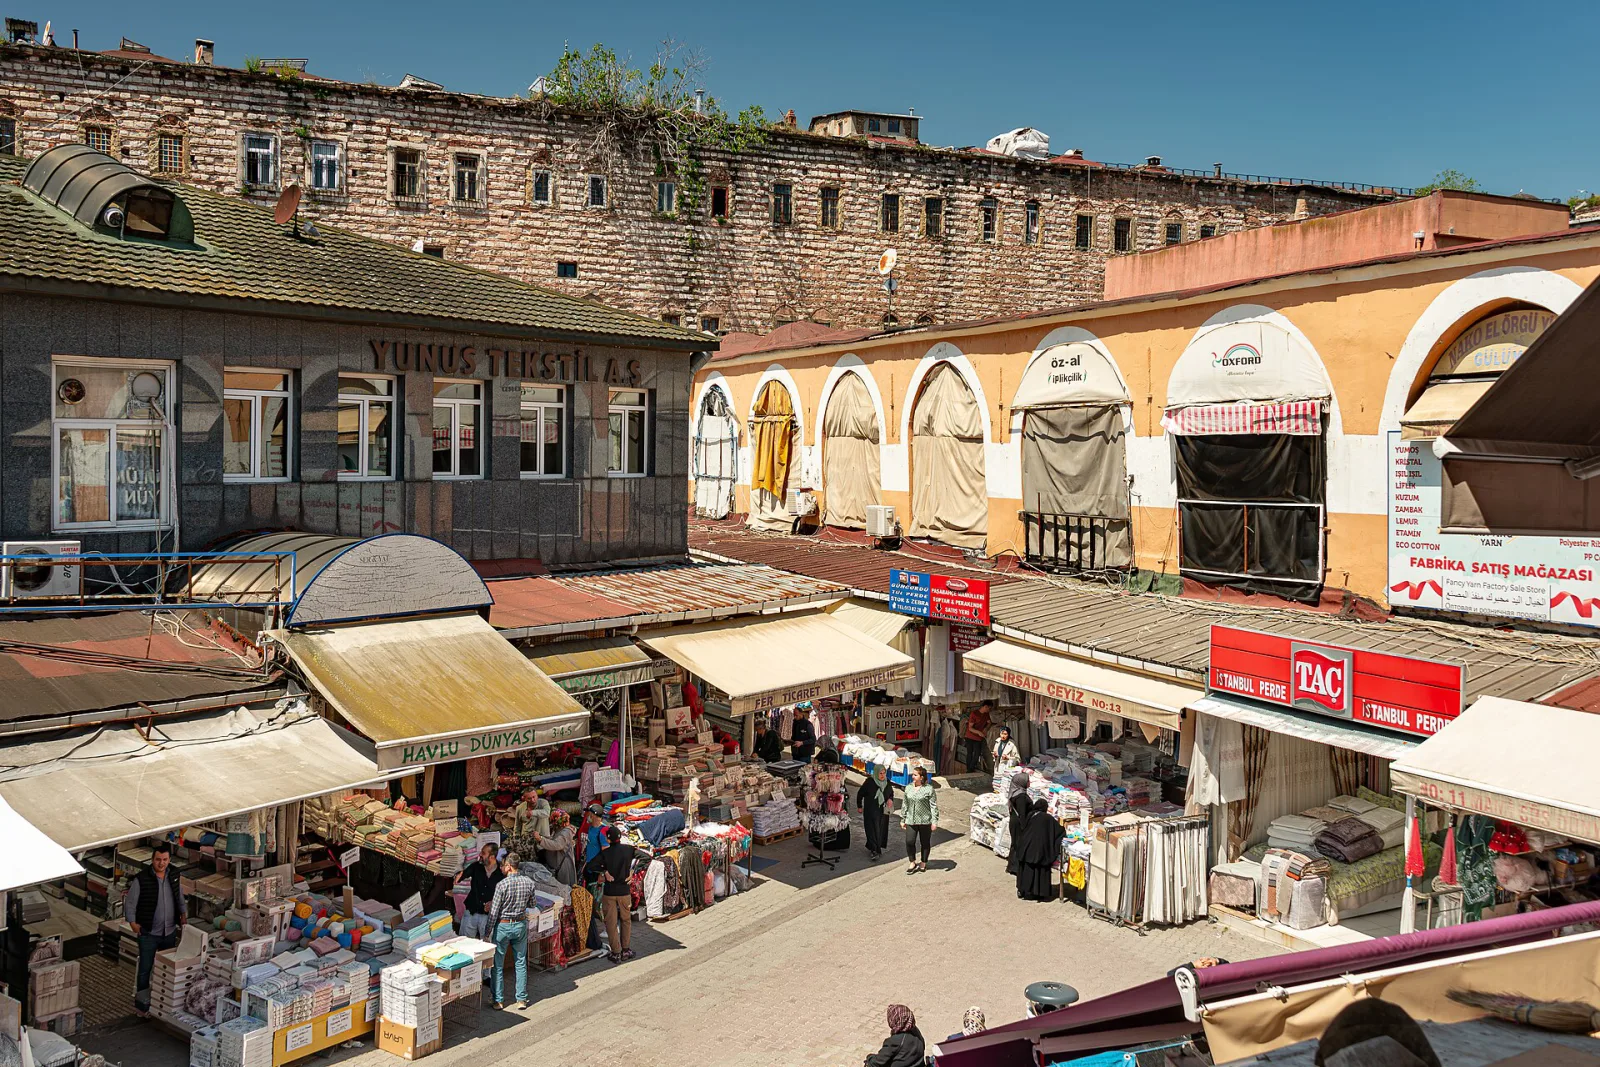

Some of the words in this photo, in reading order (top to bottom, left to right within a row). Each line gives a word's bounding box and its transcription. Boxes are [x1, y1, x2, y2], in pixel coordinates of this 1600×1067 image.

[1448, 328, 1482, 369] NAKO
[1485, 321, 1500, 340] EL
[1502, 312, 1538, 335] ÖRGÜ
[369, 340, 477, 374] YUNUS
[486, 349, 598, 382] TEKSTİL
[1051, 354, 1082, 368] öz-al
[1222, 356, 1262, 366] OXFORD
[1051, 371, 1083, 385] iplikçilik
[1395, 447, 1419, 455] YUMOŞ
[1395, 458, 1422, 466] KRİSTAL
[1395, 506, 1423, 514] ZAMBAK
[1396, 518, 1419, 526] LEMUR
[1396, 529, 1422, 538] ETAMİN
[1410, 542, 1440, 551] COTTON
[1480, 538, 1502, 546] YARN
[1560, 538, 1589, 548] Polyester
[1410, 556, 1466, 572] FABRİKA
[1472, 562, 1510, 578] SATIŞ
[1514, 563, 1592, 581] MAĞAZASI
[1446, 578, 1466, 588] Fancy
[1483, 582, 1508, 592] Factory
[1526, 586, 1546, 594] Store
[755, 696, 774, 708] FER
[782, 686, 820, 703] TİCARET
[828, 681, 846, 694] KNS
[852, 670, 896, 688] HEDİYELİK
[1296, 661, 1342, 703] TAÇ
[1260, 681, 1286, 700] PERDE
[1092, 698, 1122, 714] NO:13
[884, 719, 912, 729] PERDE
[402, 741, 459, 764] HAVLU
[470, 729, 536, 753] DÜNYASI
[552, 725, 572, 738] 3-4-5
